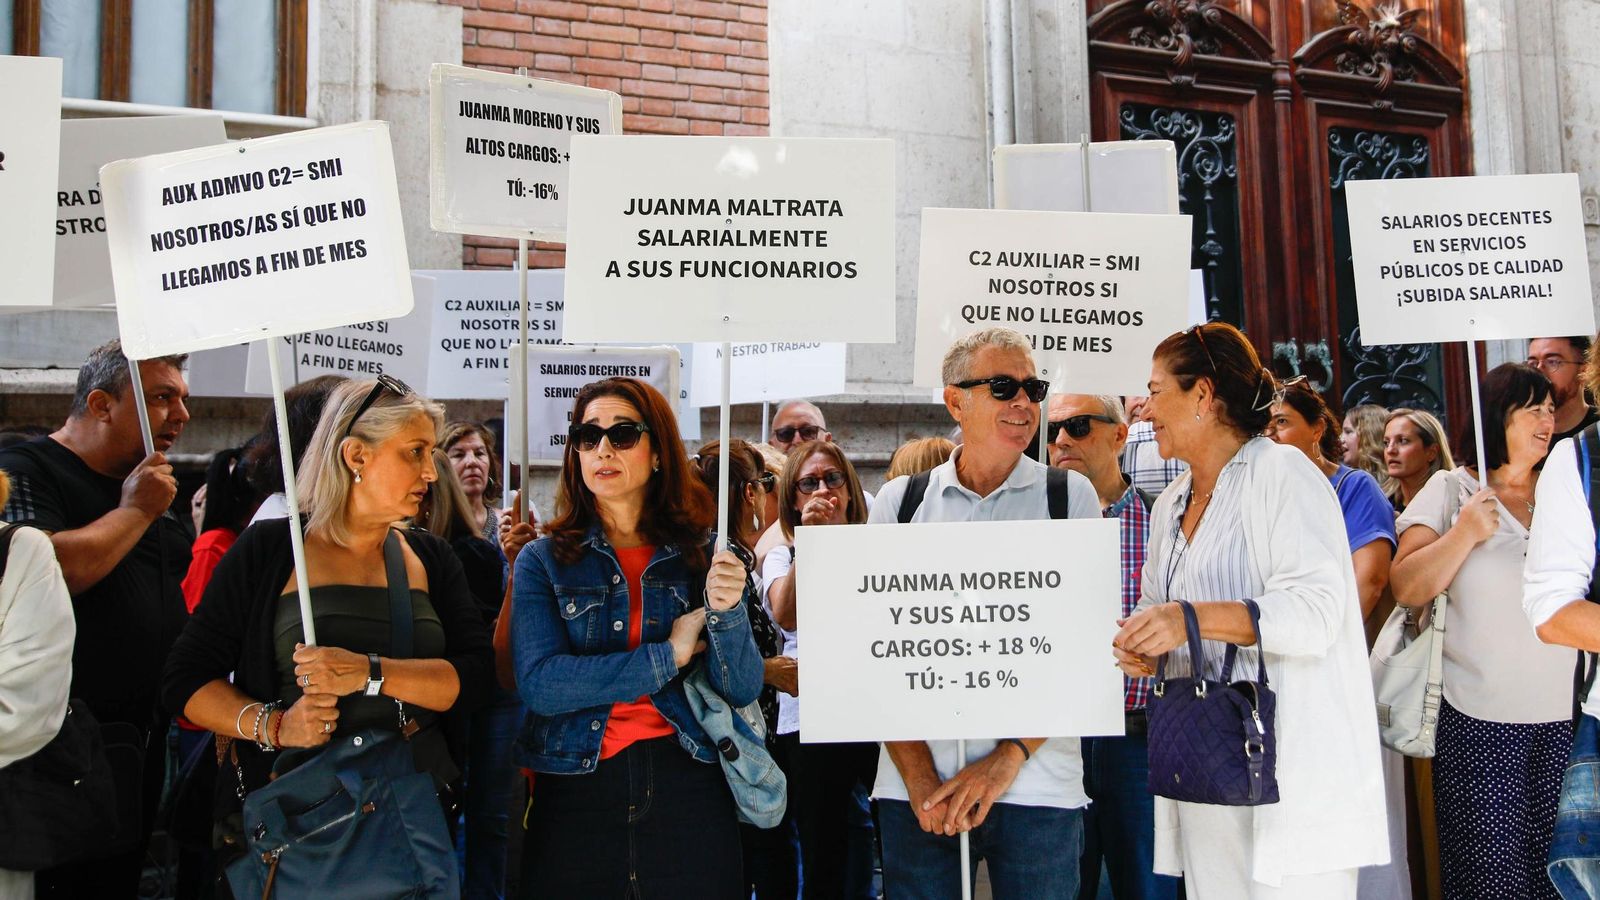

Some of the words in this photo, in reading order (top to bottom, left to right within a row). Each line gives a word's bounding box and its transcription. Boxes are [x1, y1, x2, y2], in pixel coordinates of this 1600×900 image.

[459, 100, 511, 123] JUANMA
[513, 108, 564, 130] MORENO
[565, 115, 573, 131] Y
[576, 117, 600, 134] SUS
[466, 137, 505, 157] ALTOS
[508, 142, 561, 163] CARGOS:
[162, 183, 197, 206] AUX
[201, 171, 264, 199] ADMVO
[268, 167, 303, 188] C2=
[307, 158, 343, 180] SMI
[507, 178, 526, 197] TÚ:
[528, 183, 558, 200] -16%
[58, 190, 85, 207] RA
[623, 198, 721, 216] JUANMA
[728, 199, 843, 216] MALTRATA
[56, 217, 106, 235] STRO
[151, 213, 278, 252] NOSOTROS/AS
[281, 206, 299, 229] SÍ
[303, 203, 338, 226] QUE
[341, 198, 366, 219] NO
[1381, 214, 1463, 230] SALARIOS
[1467, 210, 1552, 226] DECENTES
[637, 229, 828, 247] SALARIALMENTE
[1413, 239, 1435, 253] EN
[1439, 236, 1526, 252] SERVICIOS
[162, 259, 251, 291] LLEGAMOS
[256, 256, 268, 275] A
[271, 251, 300, 272] FIN
[303, 246, 326, 267] DE
[329, 239, 367, 262] MES
[605, 261, 621, 278] A
[627, 260, 672, 278] SUS
[680, 260, 858, 279] FUNCIONARIOS
[969, 250, 991, 266] C2
[996, 252, 1084, 269] AUXILIAR
[1105, 255, 1140, 271] SMI
[1380, 261, 1464, 279] PÚBLICOS
[1468, 262, 1489, 275] DE
[1494, 259, 1563, 274] CALIDAD
[988, 279, 1095, 297] NOSOTROS
[1100, 282, 1117, 297] SI
[1397, 288, 1465, 307] ¡SUBIDA
[1469, 283, 1552, 300] SALARIAL!
[445, 300, 462, 311] C2
[546, 301, 564, 311] SM
[543, 320, 555, 330] SI
[961, 305, 1000, 323] QUE
[1007, 306, 1034, 322] NO
[1040, 308, 1143, 326] LLEGAMOS
[377, 321, 388, 333] SI
[315, 333, 333, 346] NO
[337, 336, 403, 356] LLEGAMOS
[441, 339, 471, 352] QUE
[476, 339, 496, 349] NO
[716, 344, 767, 358] NESTRO
[1043, 335, 1067, 351] DE
[1073, 336, 1112, 353] MES
[301, 353, 310, 366] A
[314, 355, 334, 368] FIN
[338, 358, 353, 371] DE
[357, 361, 383, 374] MES
[463, 358, 472, 368] A
[476, 358, 499, 368] FIN
[540, 364, 586, 376] SALARIOS
[589, 365, 636, 376] DECENTES
[639, 366, 650, 376] EN
[544, 387, 581, 398] SERVIC
[550, 434, 567, 446] ¡SU
[857, 573, 954, 593] JUANMA
[960, 570, 1061, 590] MORENO
[889, 607, 903, 625] Y
[909, 606, 954, 624] SUS
[960, 604, 1031, 623] ALTOS
[871, 638, 972, 658] CARGOS:
[978, 640, 991, 653] +
[998, 637, 1023, 655] 18
[1030, 636, 1051, 654] %
[905, 666, 944, 690] TÚ:
[965, 671, 991, 689] 16
[996, 669, 1018, 688] %
